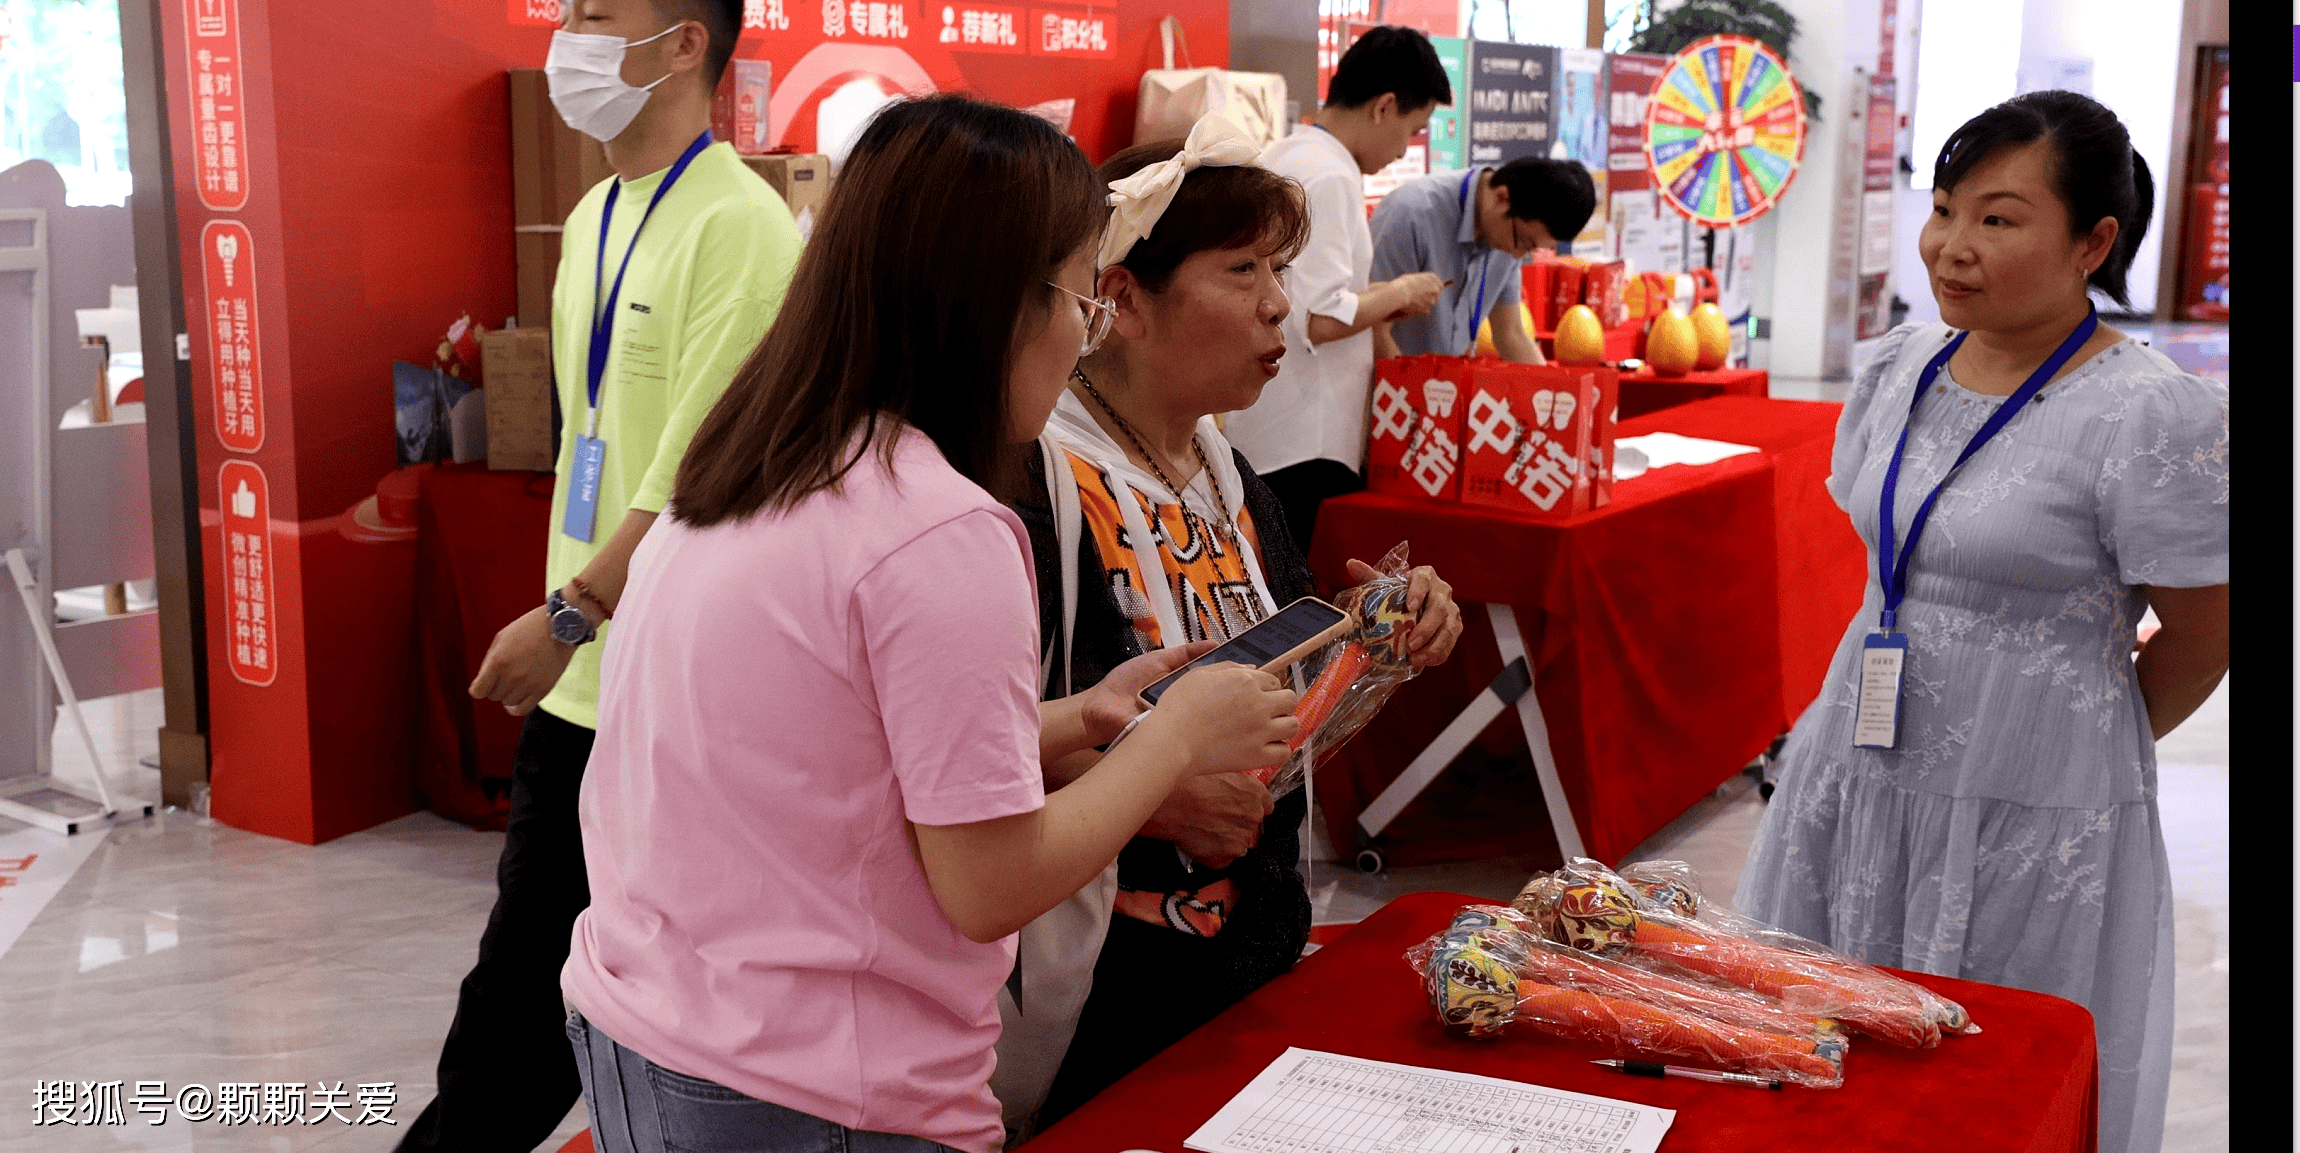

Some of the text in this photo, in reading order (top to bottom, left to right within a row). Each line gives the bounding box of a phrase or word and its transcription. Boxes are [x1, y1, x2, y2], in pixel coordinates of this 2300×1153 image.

[850, 2, 908, 38] 专属礼
[961, 9, 1017, 46] 荐新礼
[1061, 17, 1108, 51] 积分礼
[214, 56, 239, 193] 一对一更靠谱
[216, 297, 239, 435] 立得用种植牙
[233, 297, 256, 437] 当天种当天用
[1372, 378, 1459, 498] 中诺
[1467, 388, 1578, 512] 中诺
[231, 531, 252, 666] 微创精准种植
[247, 533, 269, 669] 更舒适更快速
